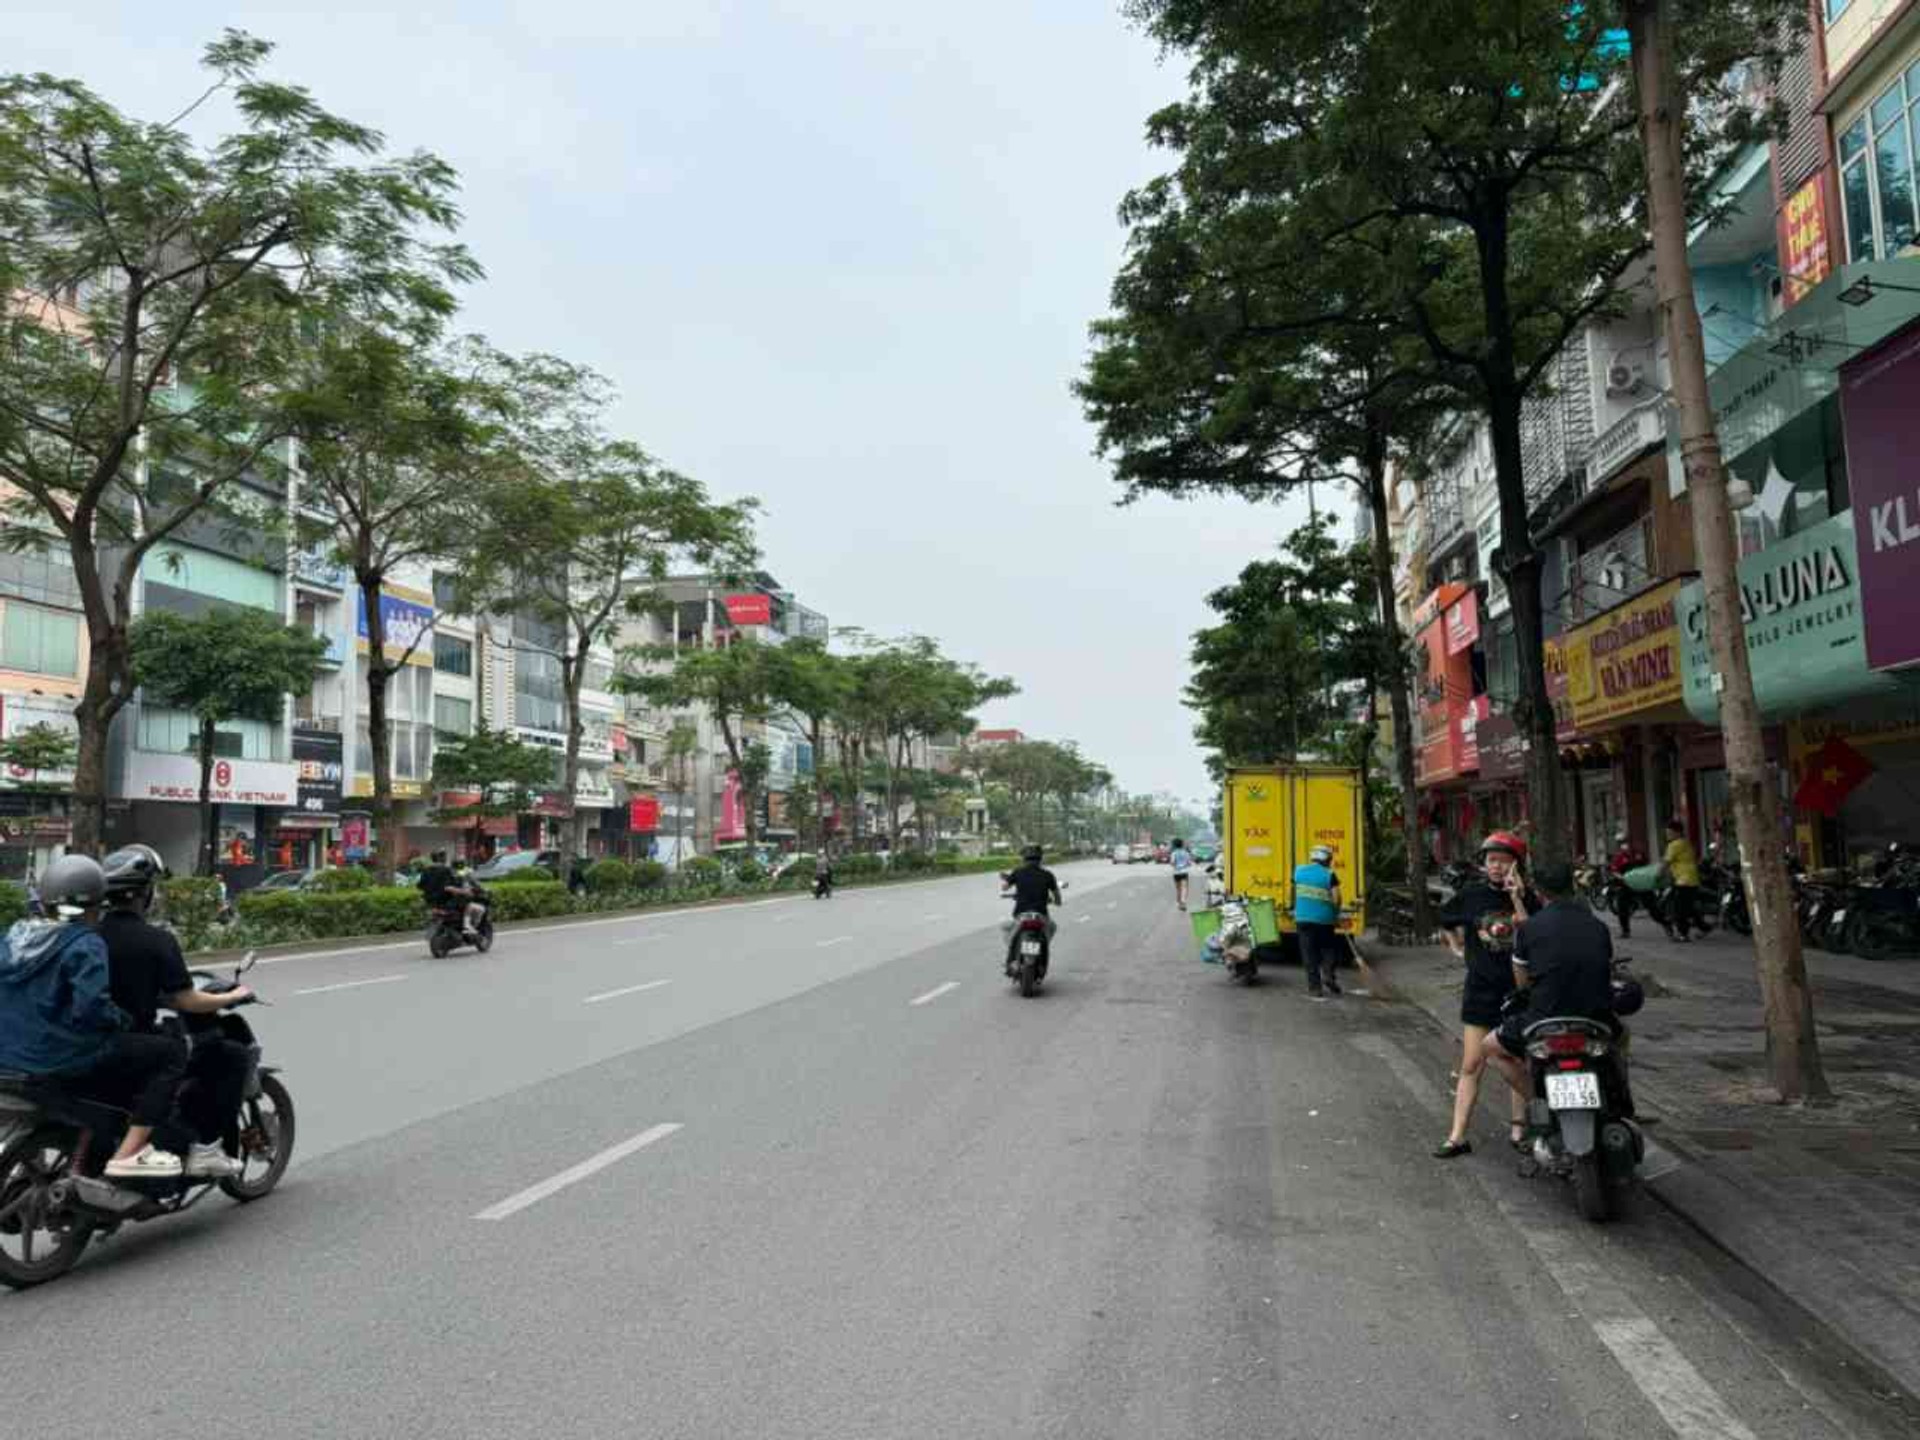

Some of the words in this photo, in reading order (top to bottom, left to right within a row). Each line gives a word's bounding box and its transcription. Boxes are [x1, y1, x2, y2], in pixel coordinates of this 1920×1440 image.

[1788, 602, 1853, 636] JEWELRY
[150, 786, 193, 799] PUBLIC
[236, 791, 287, 803] VIETNAM
